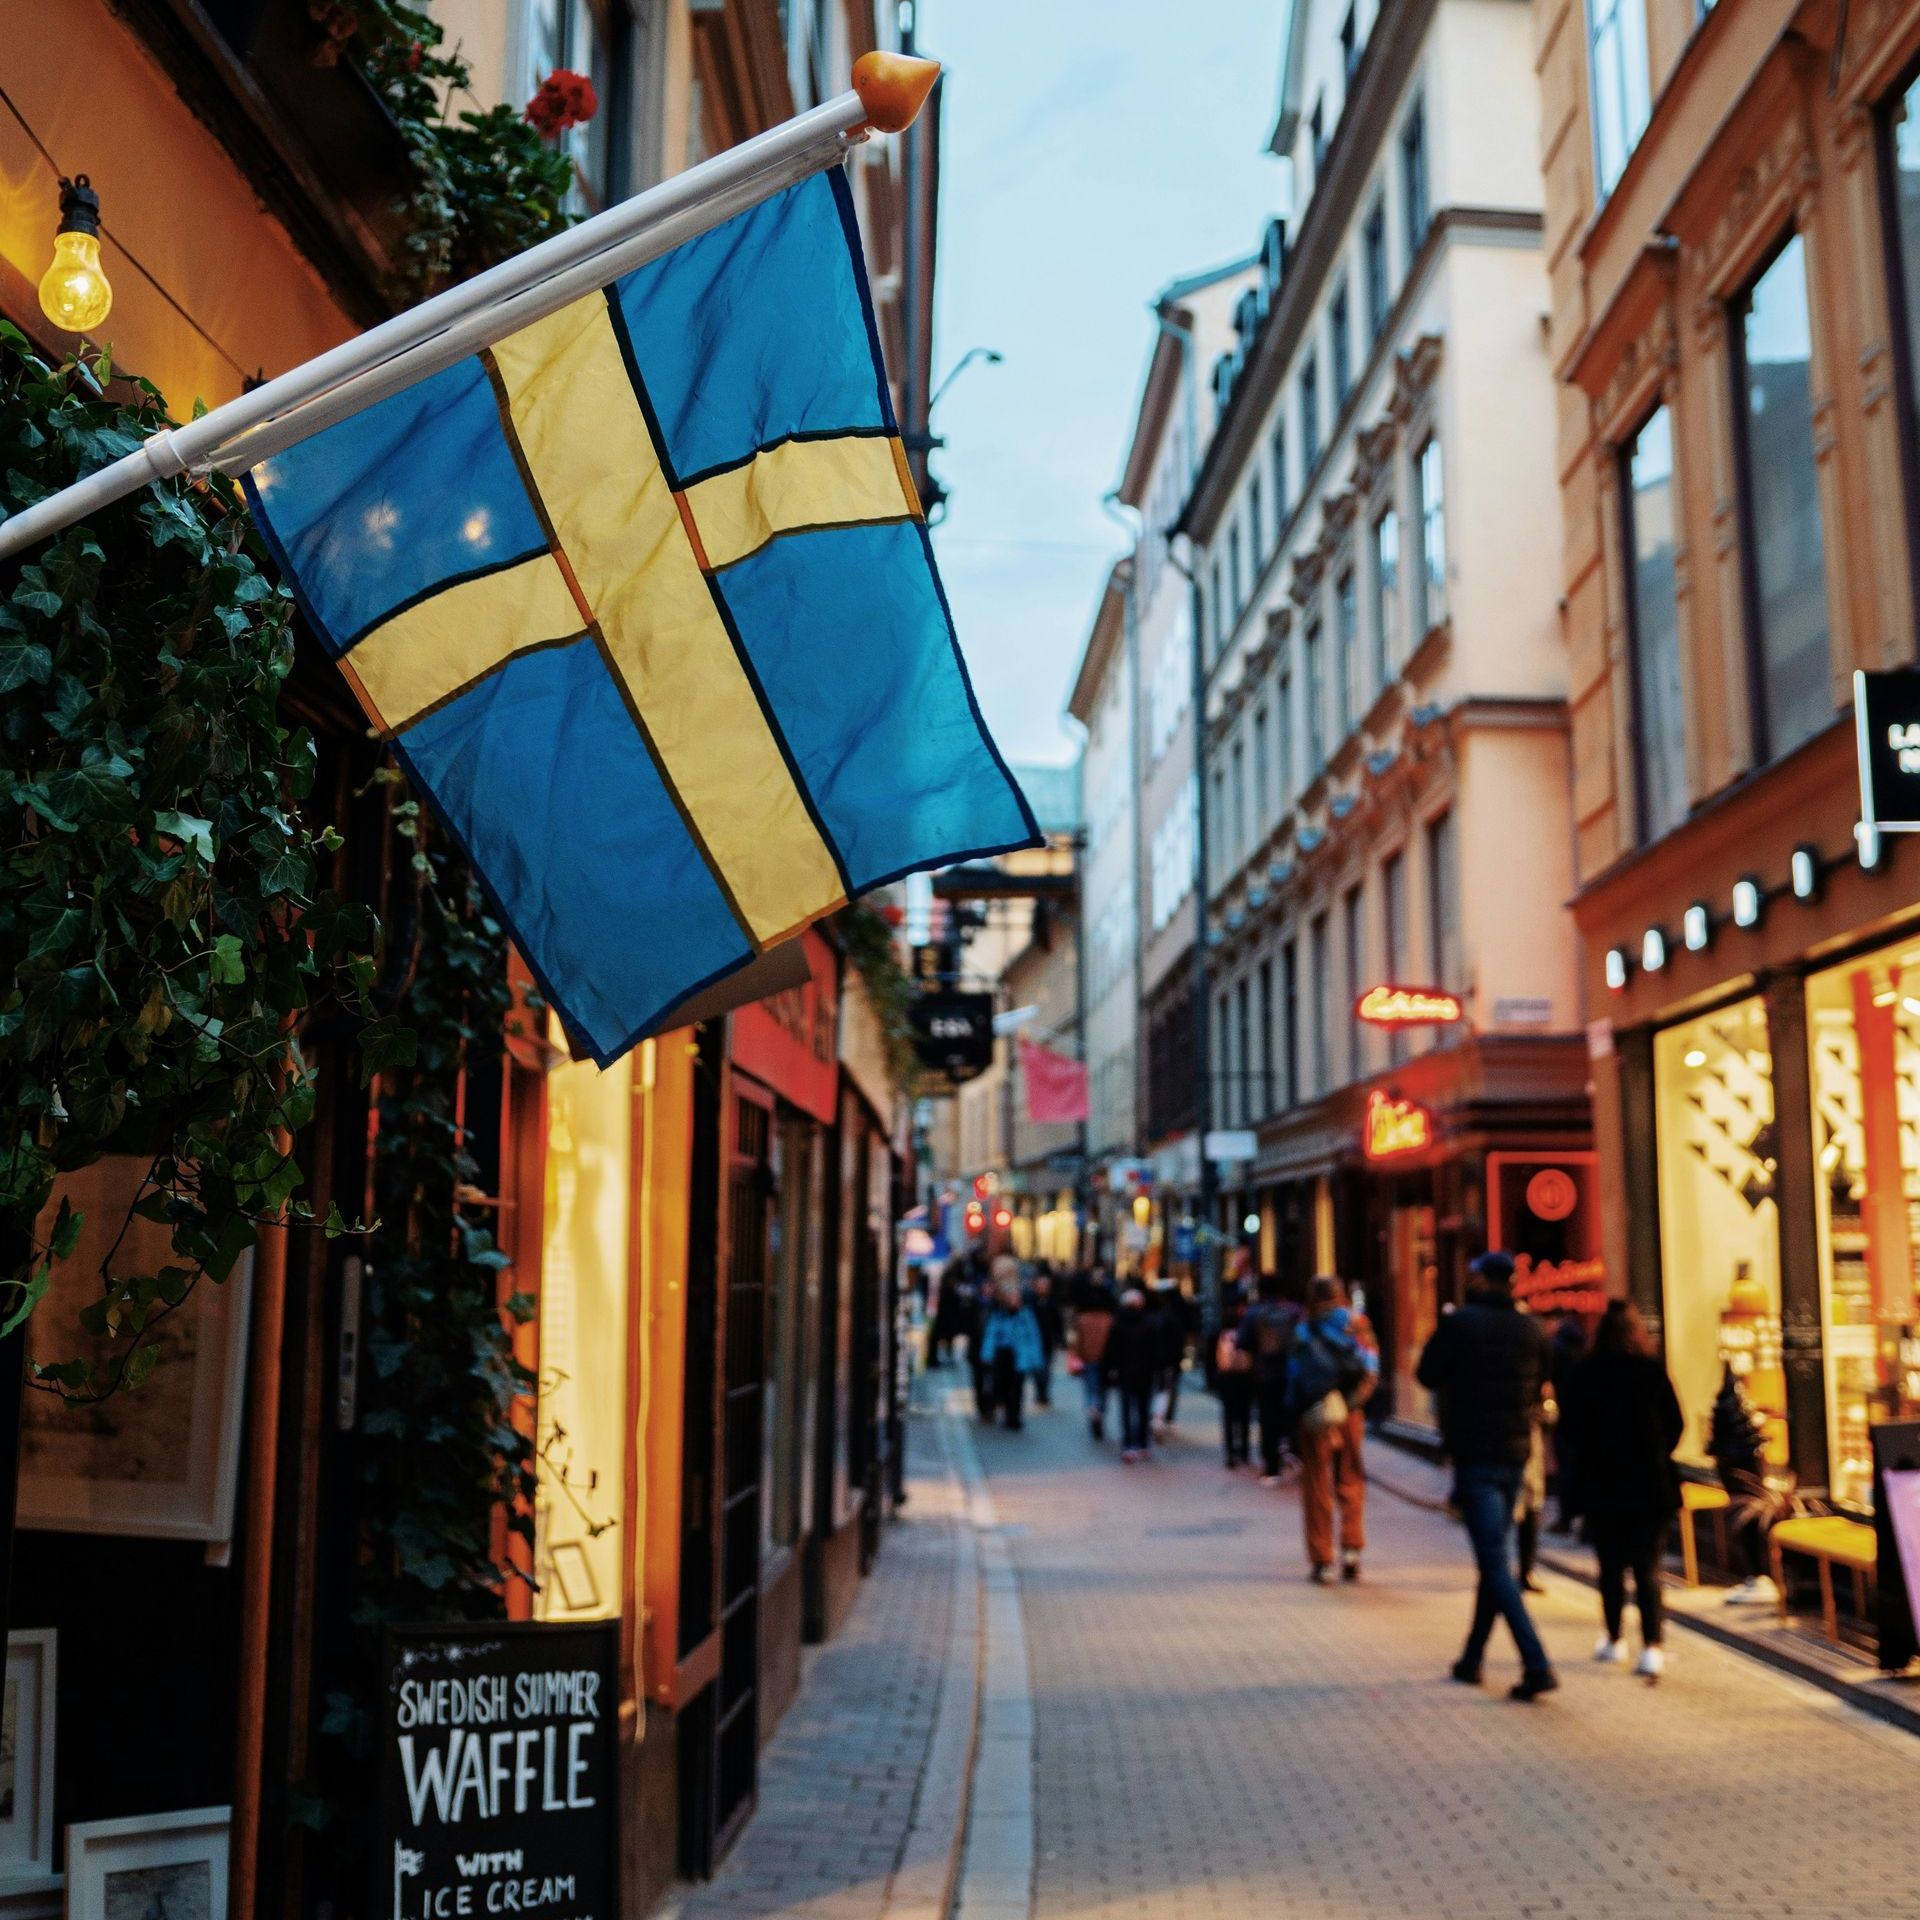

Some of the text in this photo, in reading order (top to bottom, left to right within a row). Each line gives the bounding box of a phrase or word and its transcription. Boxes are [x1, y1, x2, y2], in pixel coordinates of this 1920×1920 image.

[398, 1670, 600, 1727] SWEDISH SUMMER
[397, 1721, 596, 1827] WAFFLE
[456, 1849, 523, 1876] WITH
[423, 1875, 575, 1919] ICE CREAM
